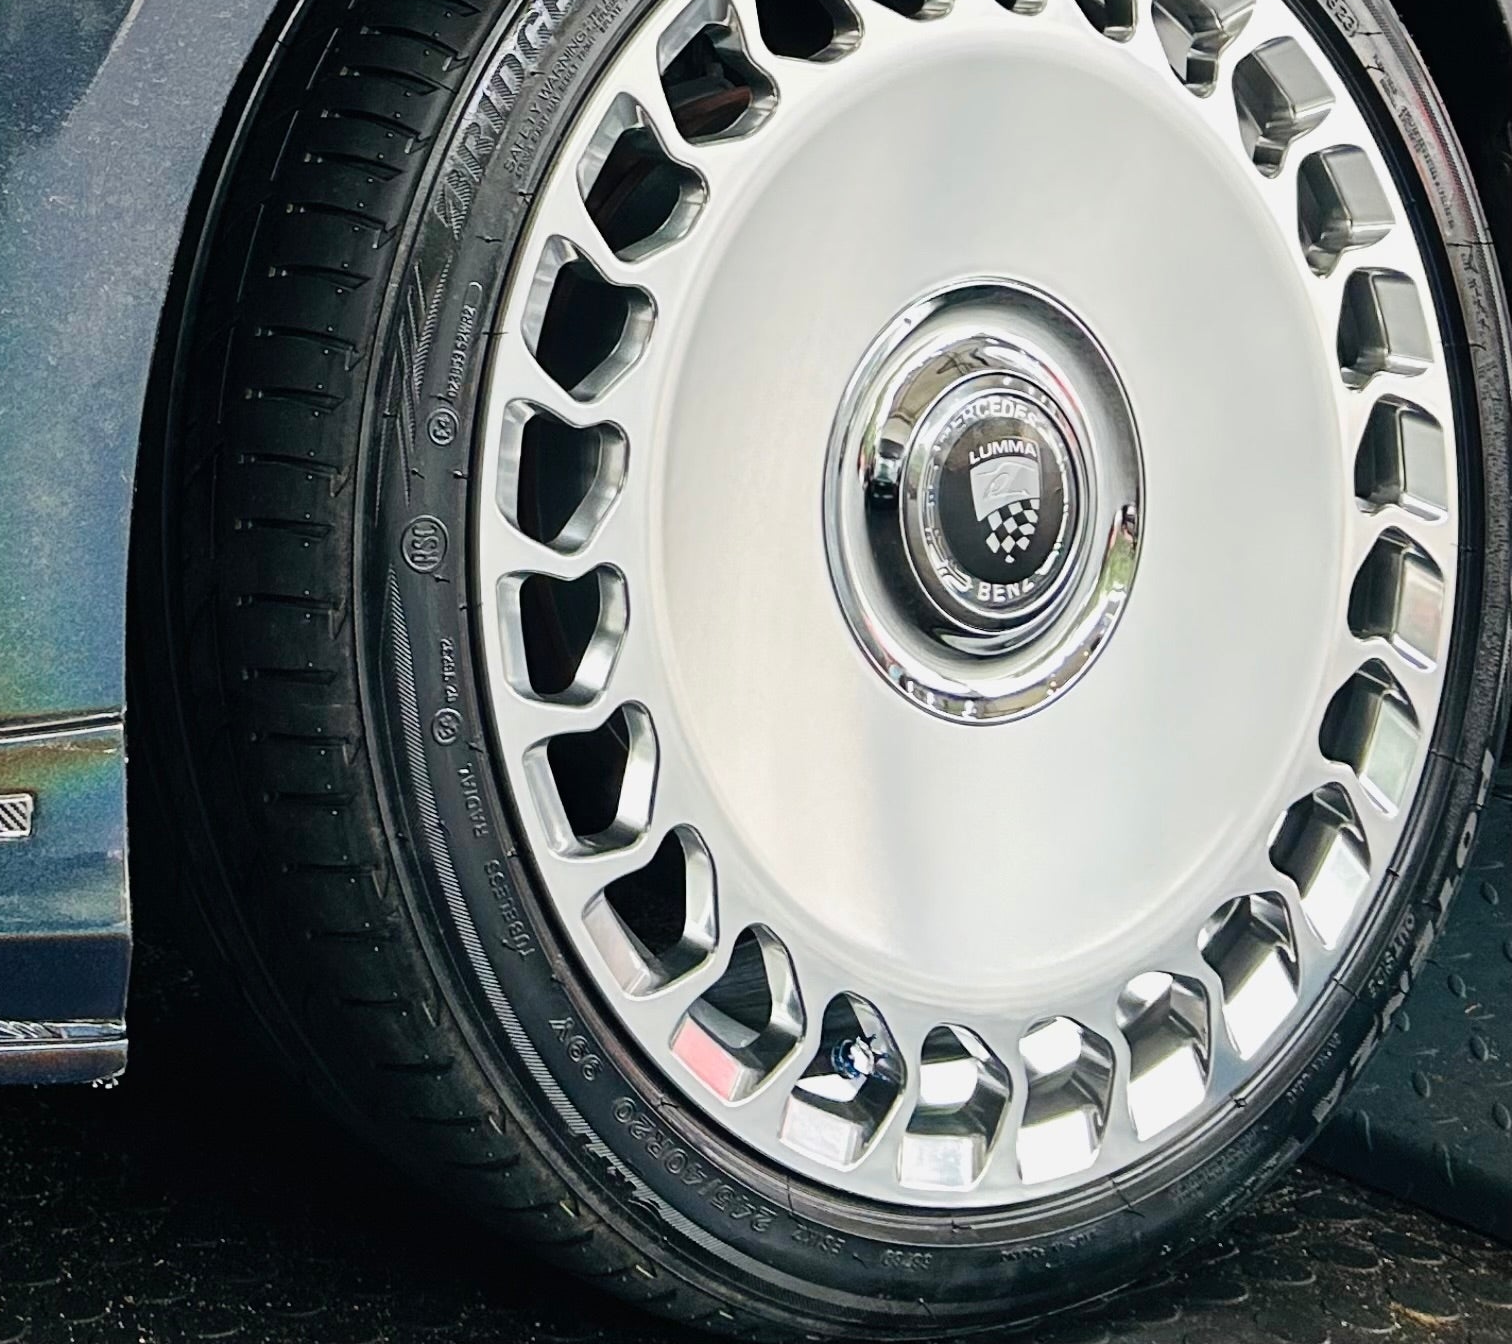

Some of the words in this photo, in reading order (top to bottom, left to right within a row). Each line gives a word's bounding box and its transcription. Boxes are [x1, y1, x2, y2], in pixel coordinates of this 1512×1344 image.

[501, 102, 545, 172] SAFETY
[968, 439, 1038, 465] LUMMA
[976, 578, 1036, 603] BENZ
[456, 762, 489, 839] RADIAL
[484, 858, 536, 957] TUBELESS
[548, 1015, 604, 1081] 99Y
[611, 1095, 779, 1233] 245/40R20
